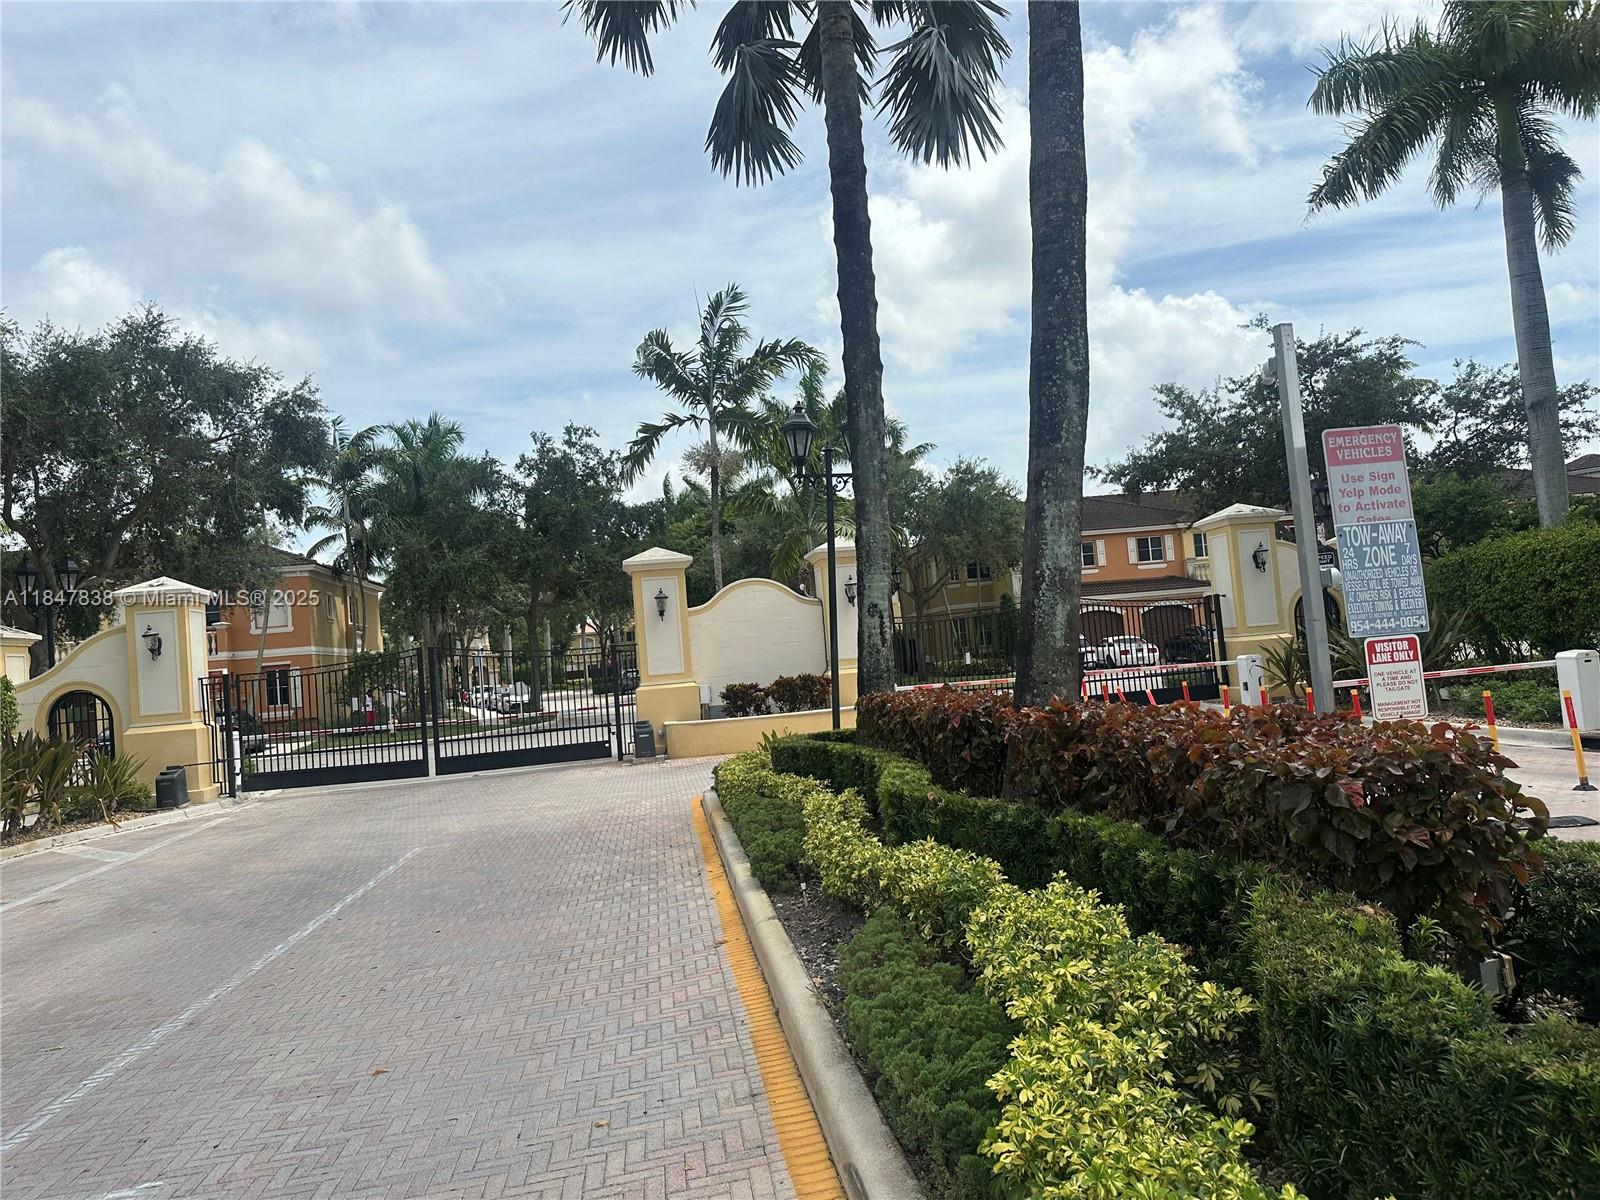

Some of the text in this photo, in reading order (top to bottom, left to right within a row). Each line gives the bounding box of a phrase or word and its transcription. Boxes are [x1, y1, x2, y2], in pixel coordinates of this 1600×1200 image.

[1328, 433, 1397, 448] EMERGENCY
[1336, 446, 1392, 460] VEHICLES
[1341, 471, 1395, 484] Use Sign
[1339, 485, 1401, 499] Yelp Mode
[1338, 499, 1406, 513] to Activate
[1343, 523, 1407, 547] TOW-AWAY
[1342, 554, 1418, 570] HRS DAYS
[1343, 543, 1410, 567] 24 ZONE 7
[1344, 566, 1418, 581] UNAUTHORIZED VEHICLES OR
[1344, 580, 1367, 591] VESSELS
[1369, 579, 1381, 589] WILL
[1382, 578, 1389, 588] BE
[1390, 577, 1408, 588] TOWED
[1348, 587, 1422, 602] AT OWNERS RISK & EXPENSE
[1348, 598, 1424, 614] EXECUTIVE TOWING & RECOVERY
[1351, 616, 1426, 632] 954-444-0054
[1375, 641, 1409, 652] VISITOR
[1372, 650, 1414, 663] LANE ONLY
